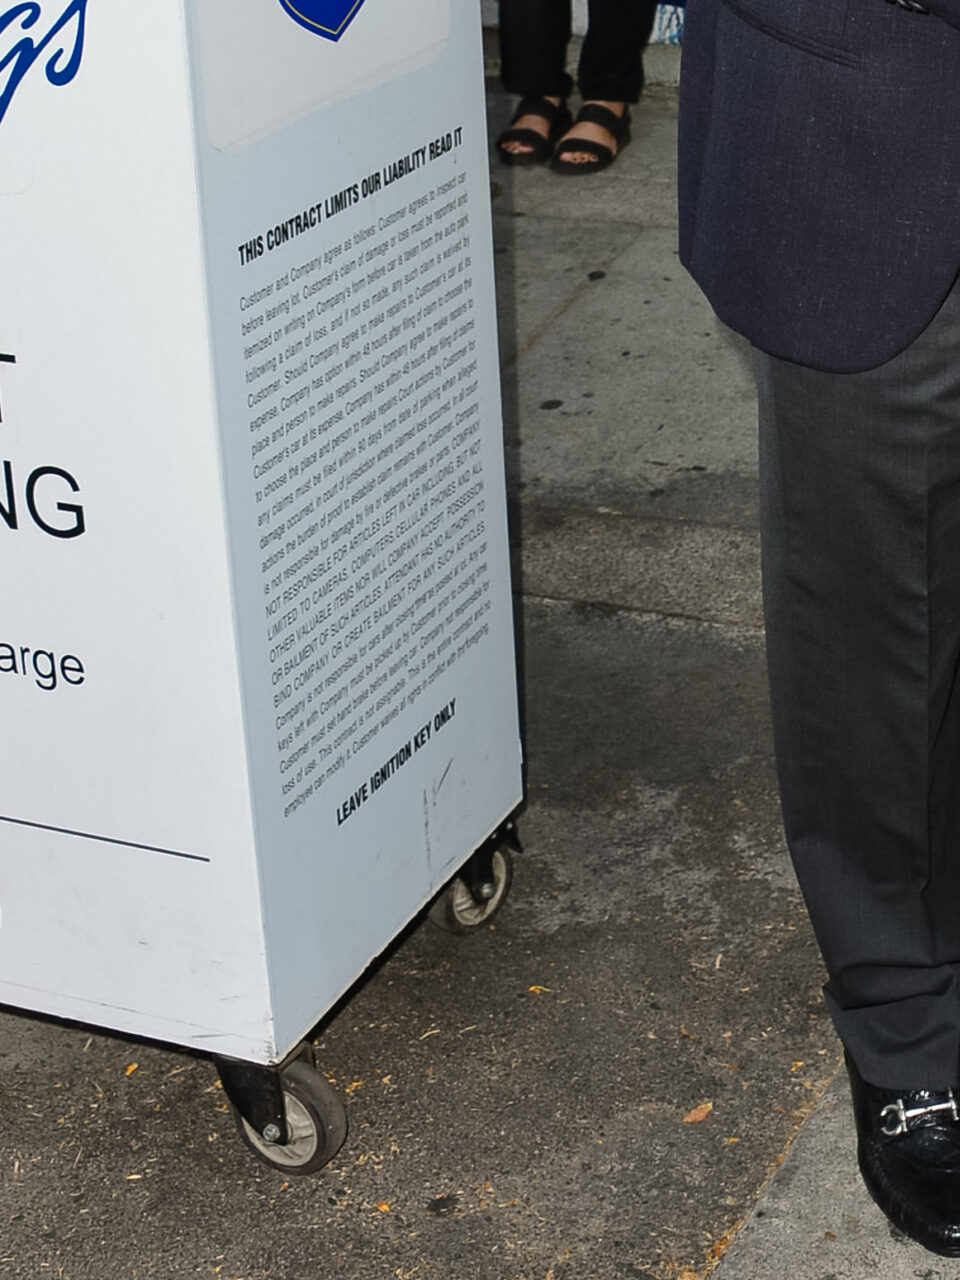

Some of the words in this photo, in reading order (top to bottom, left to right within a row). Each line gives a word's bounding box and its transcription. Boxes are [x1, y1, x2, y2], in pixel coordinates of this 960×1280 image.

[237, 234, 264, 265] THIS
[266, 202, 322, 250] CONTRACT
[324, 183, 359, 219] LIMITS
[360, 171, 381, 198] OUR
[382, 145, 426, 186] LIABILITY
[428, 132, 452, 161] READ
[453, 126, 462, 147] IT
[336, 782, 368, 826] LEAVE
[369, 740, 412, 794] IGNITION
[413, 720, 431, 752] KEY
[433, 697, 456, 732] ONLY
